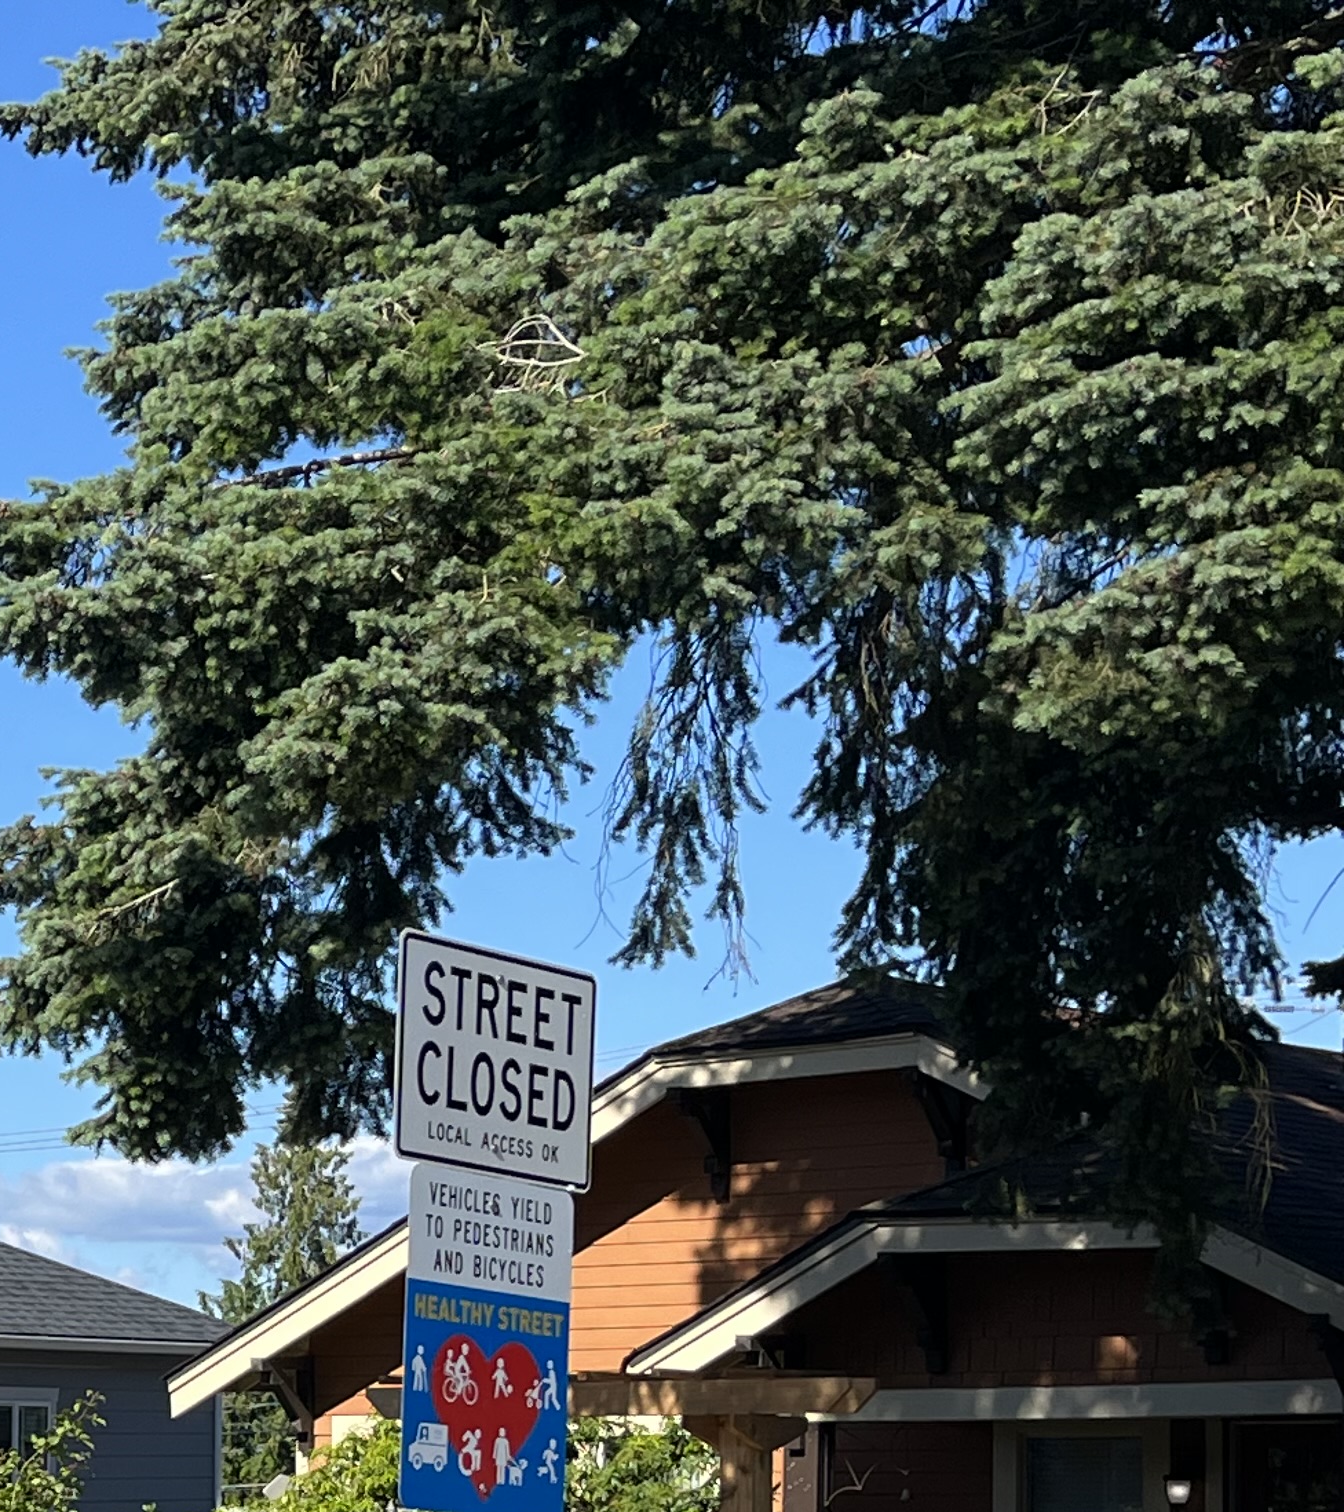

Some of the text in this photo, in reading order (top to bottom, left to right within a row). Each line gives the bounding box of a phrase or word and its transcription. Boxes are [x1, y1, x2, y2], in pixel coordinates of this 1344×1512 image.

[422, 960, 582, 1056] STREET
[417, 1040, 576, 1132] CLOSED
[428, 1121, 559, 1163] LOCAL ACCESS OK
[429, 1181, 552, 1225] VEHICLES YIELD
[426, 1213, 554, 1257] TO PEDESTRIANS
[433, 1249, 545, 1288] AND BICYCLES
[414, 1293, 564, 1338] HEALTHY STREET
